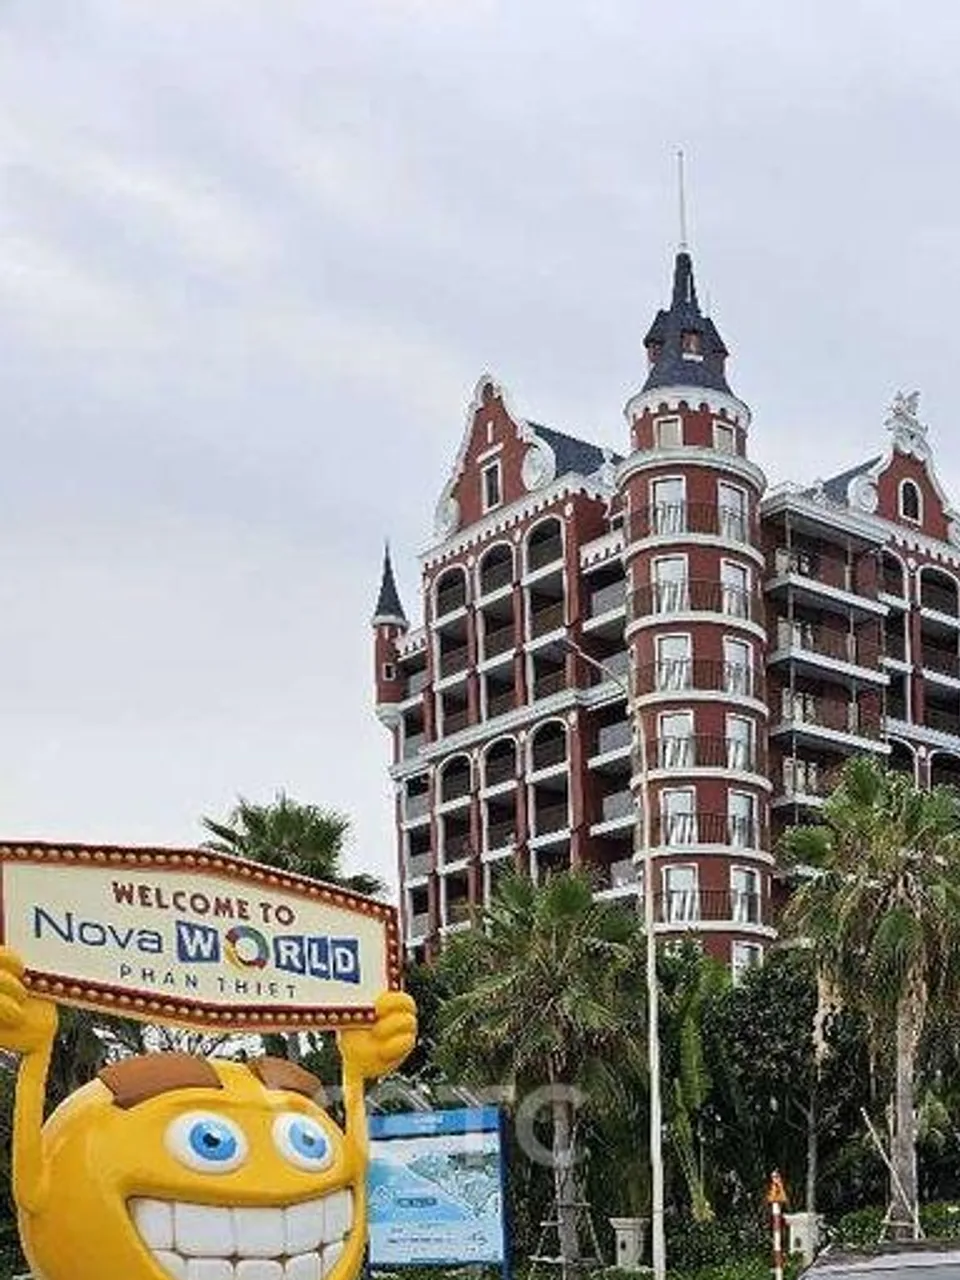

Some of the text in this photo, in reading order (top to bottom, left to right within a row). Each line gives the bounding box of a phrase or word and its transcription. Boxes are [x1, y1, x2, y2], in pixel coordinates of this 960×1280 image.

[112, 881, 296, 926] WELCOME TO
[34, 906, 360, 983] Nova WORLD
[119, 963, 199, 989] PHAN
